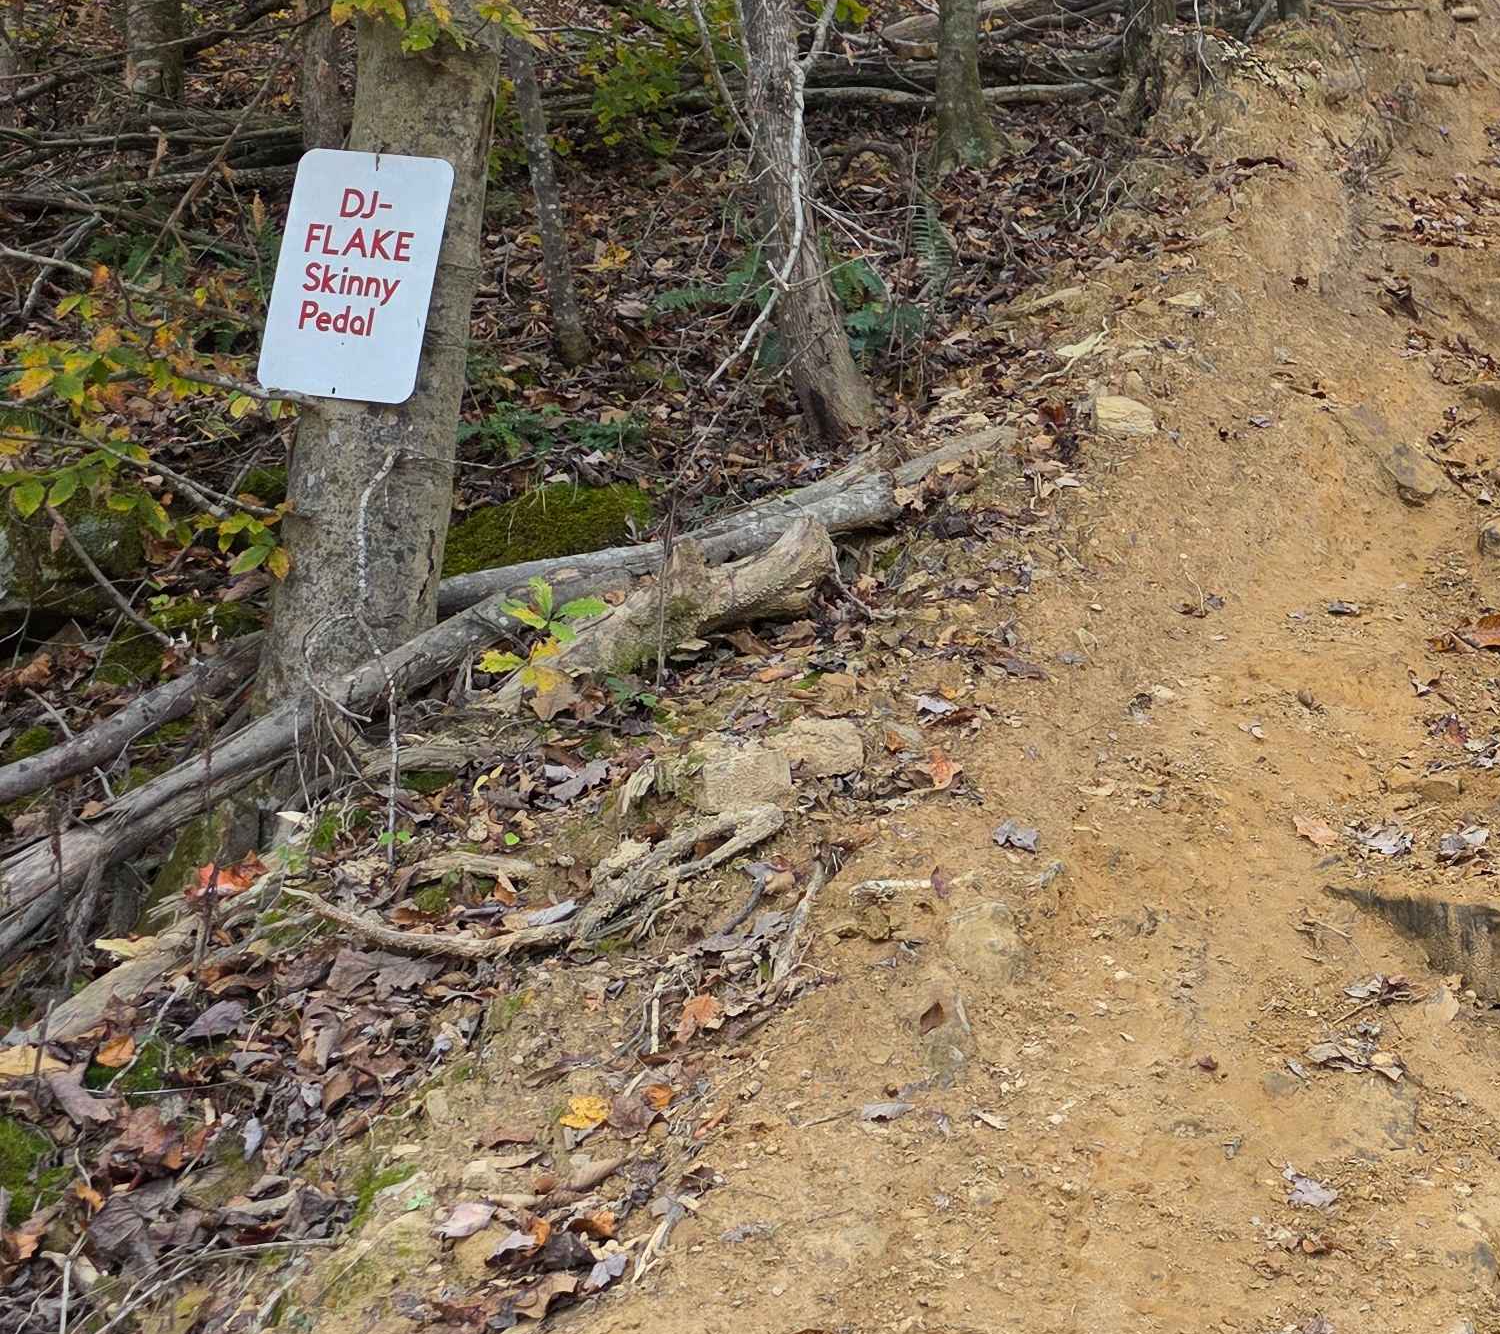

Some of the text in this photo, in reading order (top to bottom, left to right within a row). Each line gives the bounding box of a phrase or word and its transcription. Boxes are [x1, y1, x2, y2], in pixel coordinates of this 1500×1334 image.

[340, 188, 392, 219] DJ-
[304, 223, 415, 262] FLAKE
[302, 262, 400, 306] Skinny
[298, 300, 375, 336] Pedal
